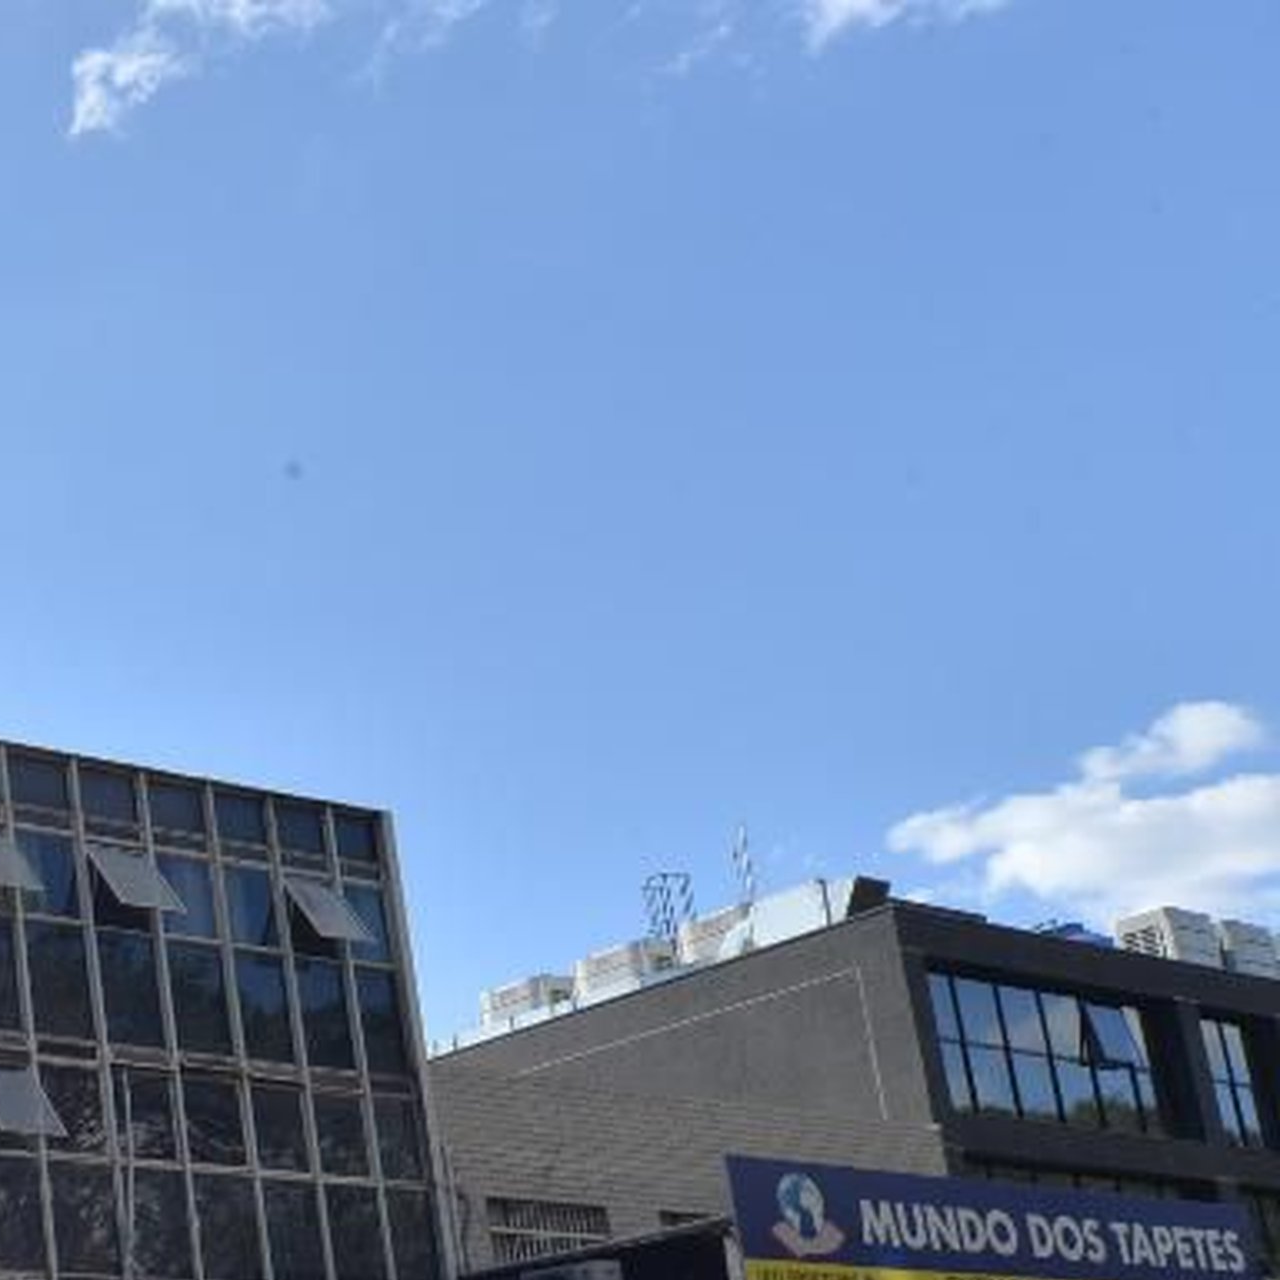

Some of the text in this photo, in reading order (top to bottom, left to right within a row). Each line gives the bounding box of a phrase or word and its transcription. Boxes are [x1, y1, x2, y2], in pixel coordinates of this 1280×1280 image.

[860, 1199, 1246, 1273] MUNDO DOS TAPETES
